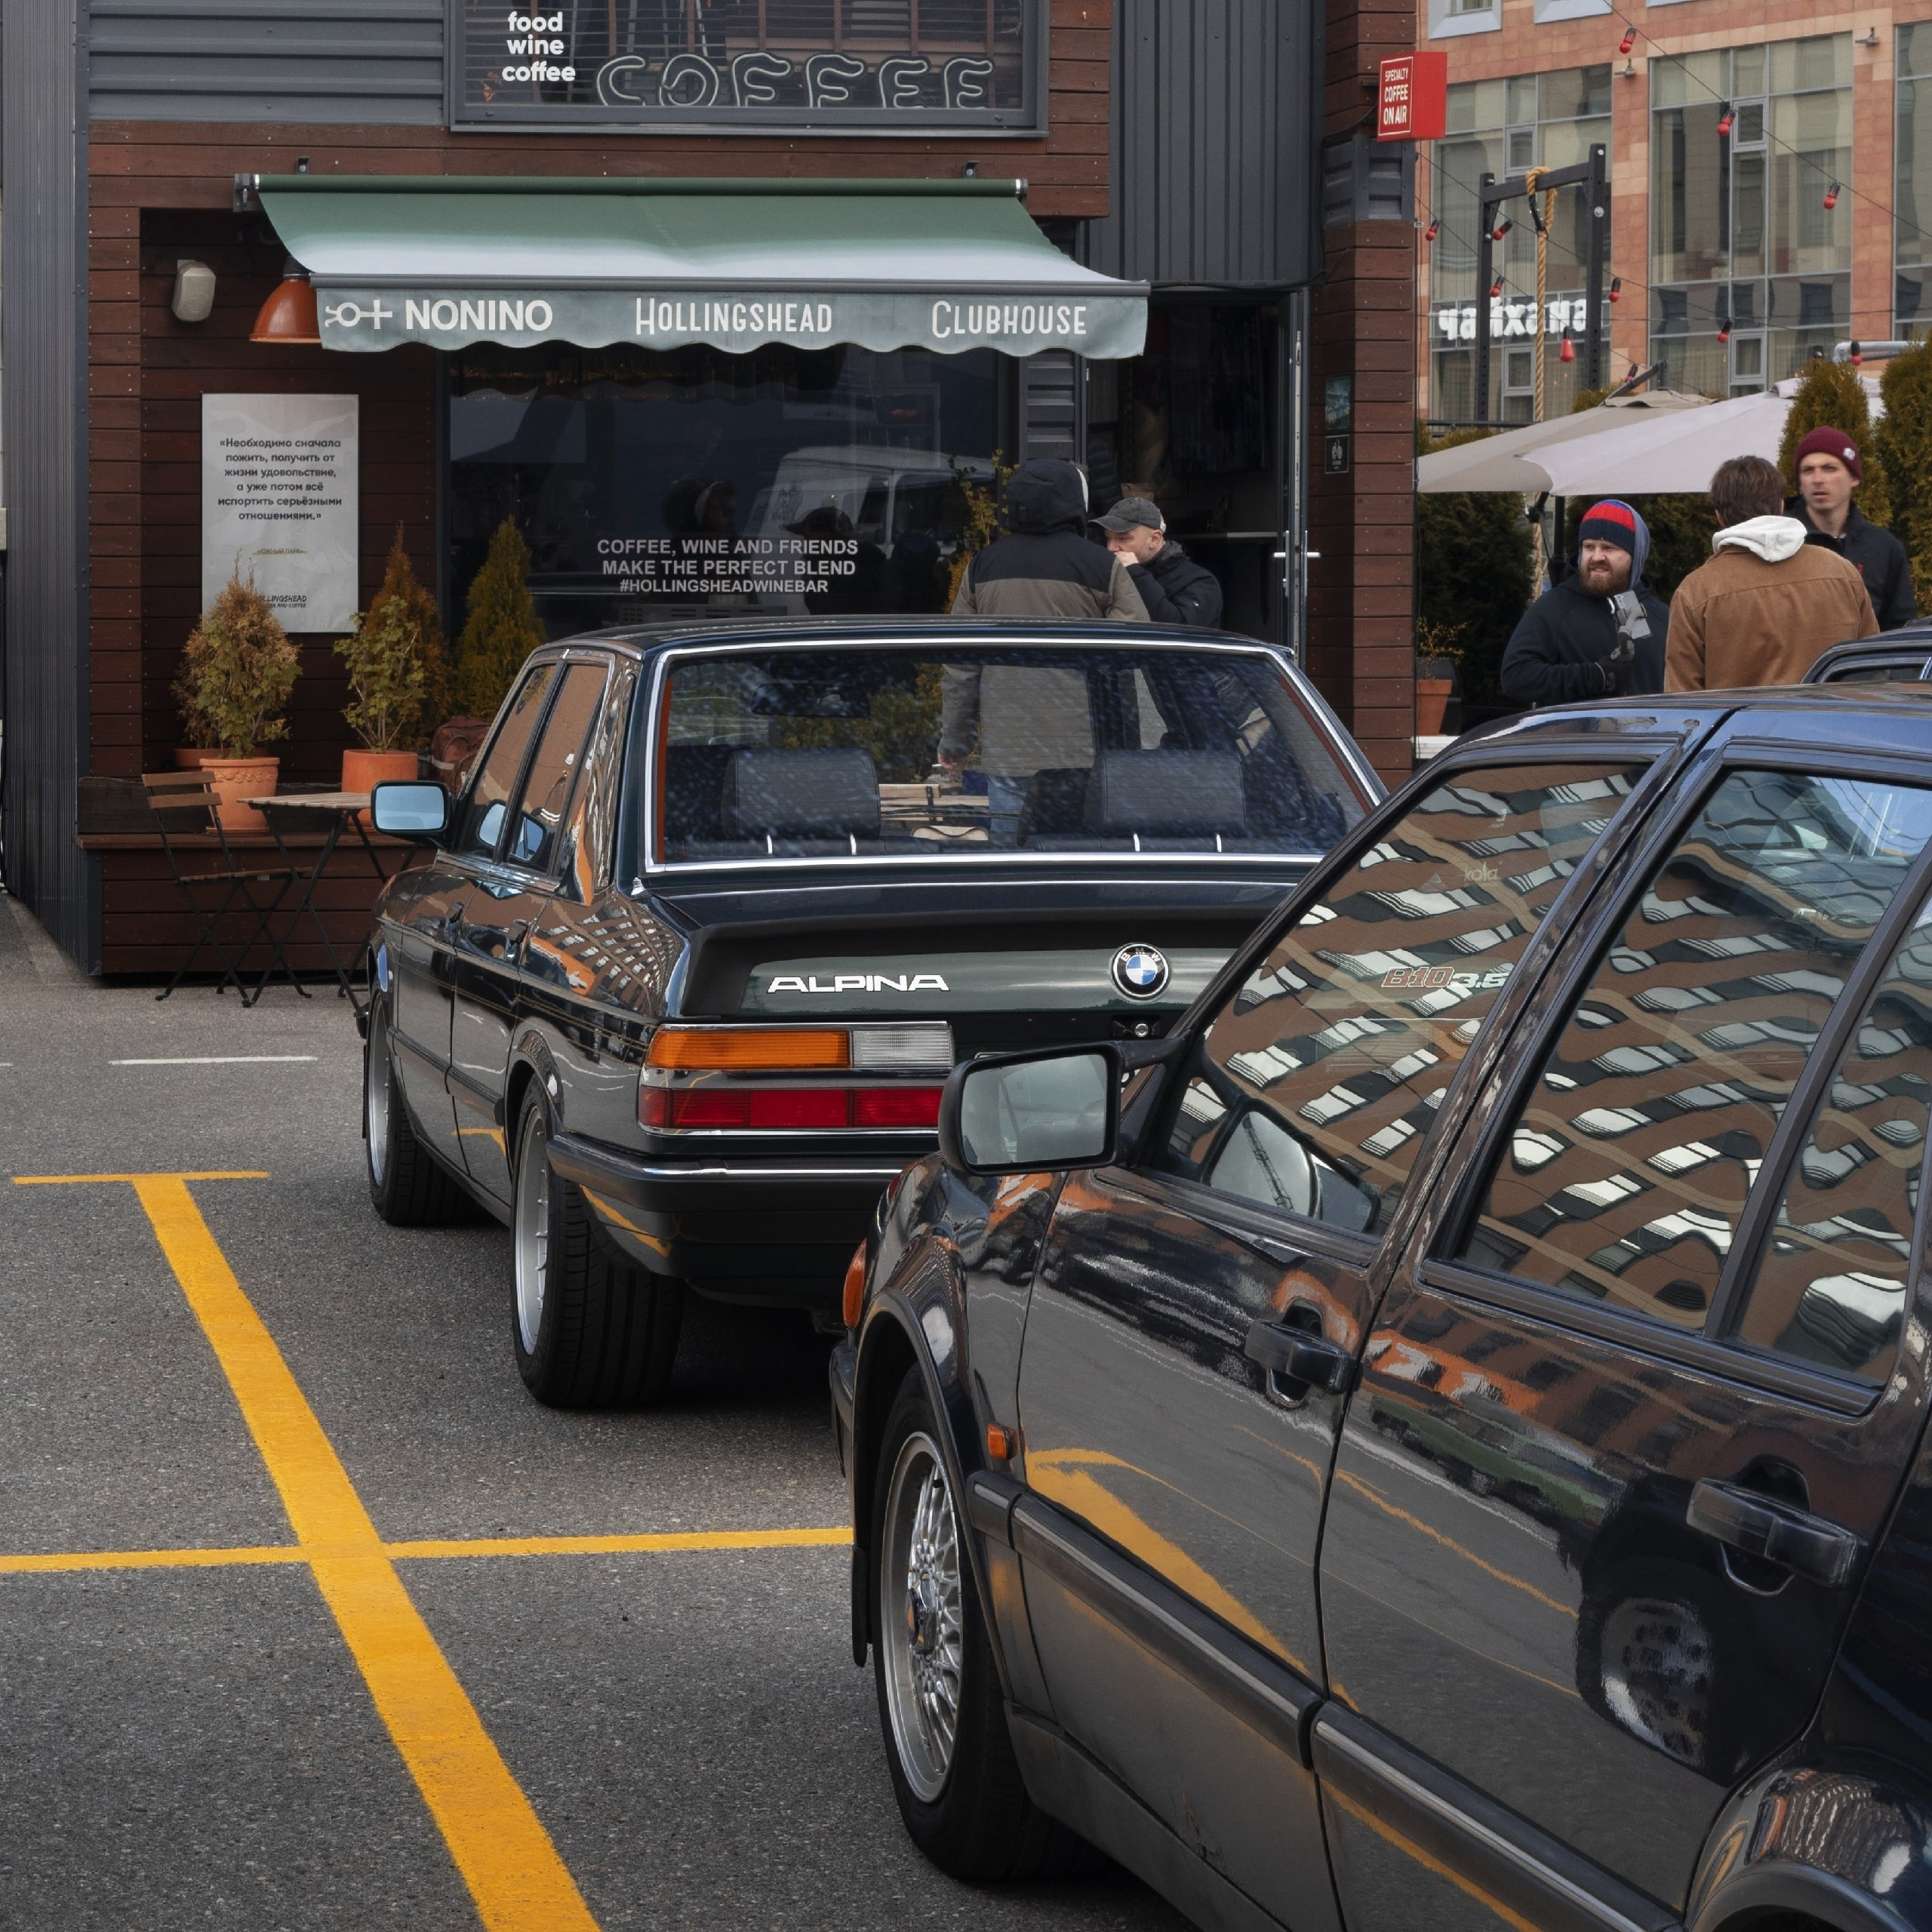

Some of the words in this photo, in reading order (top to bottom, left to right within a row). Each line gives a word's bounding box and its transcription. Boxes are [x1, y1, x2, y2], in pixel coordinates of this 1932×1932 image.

[507, 11, 564, 32] food
[506, 35, 565, 55] wine
[501, 61, 577, 82] coffee
[596, 52, 993, 109] COFFEE
[1385, 67, 1409, 82] SPECIALTY
[1384, 84, 1409, 103] COFFEE
[1383, 107, 1395, 125] ON
[1395, 105, 1407, 124] AIR
[405, 299, 553, 331] NONINO
[635, 298, 832, 335] HOLLINGSHEAD
[931, 300, 1088, 339] CLUBHOUSE
[220, 438, 292, 449] «Необходимо
[294, 438, 341, 448] сначала
[226, 454, 268, 463] пожить,
[271, 454, 320, 465] получить
[224, 469, 258, 477] жизни
[260, 468, 337, 479] удовольствие,
[246, 483, 267, 494] уже
[270, 483, 303, 491] потом
[305, 481, 324, 491] всё
[217, 497, 274, 509] испортить
[276, 495, 342, 508] серьёзными
[597, 540, 675, 556] COFFEE,
[682, 540, 729, 554] WINE
[734, 540, 774, 554] AND
[780, 540, 859, 554] FRIENDS
[603, 561, 656, 575] MAKE
[661, 561, 698, 575] THE
[704, 561, 789, 575] PERFECT
[794, 561, 857, 575] BLEND
[620, 580, 829, 593] #HOLLINGSHEADWINEBAR
[1120, 947, 1162, 963] BMW
[767, 975, 949, 994] ALPINA
[1381, 966, 1455, 988] B10
[1452, 973, 1509, 989] 3.5
